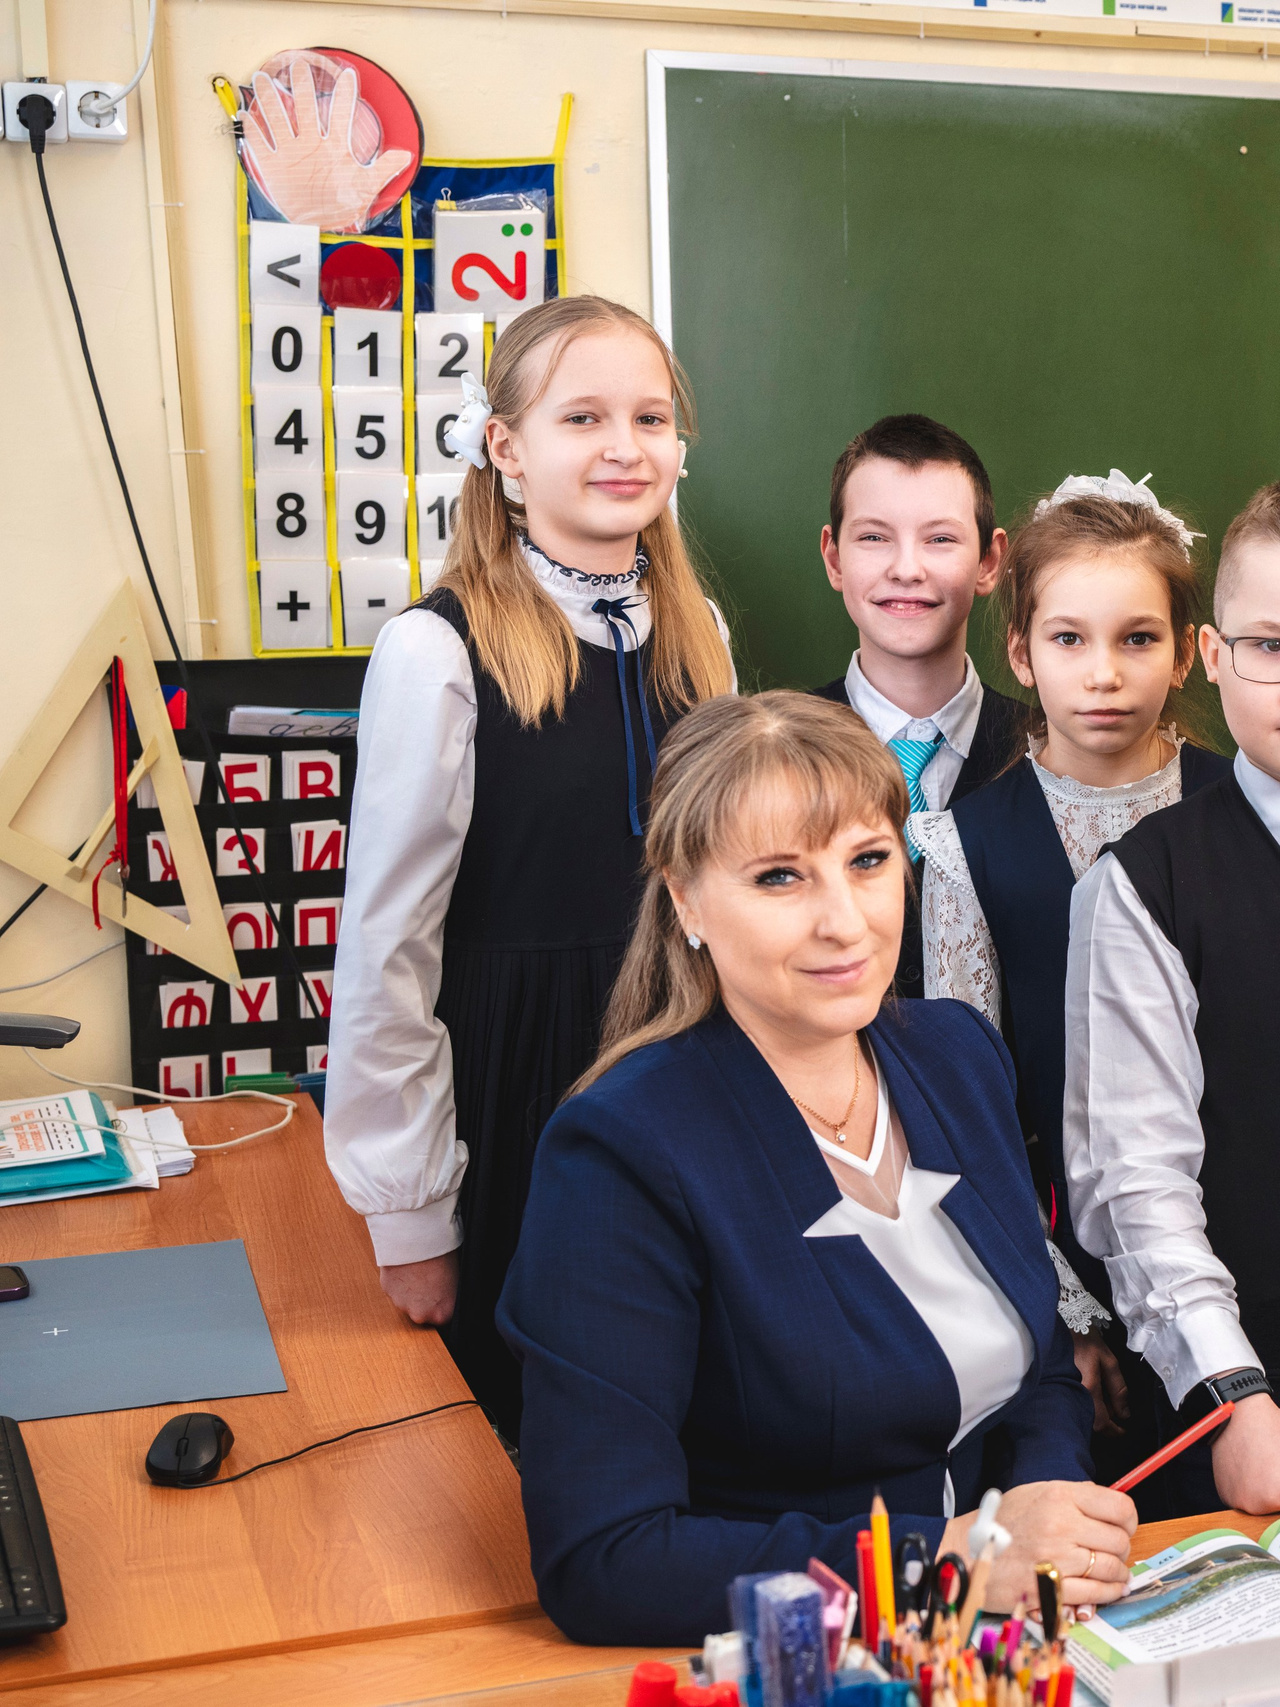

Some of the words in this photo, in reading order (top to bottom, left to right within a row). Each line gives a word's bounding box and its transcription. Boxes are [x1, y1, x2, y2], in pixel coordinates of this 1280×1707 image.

[271, 326, 302, 372] 0
[357, 332, 379, 376] 1
[438, 333, 469, 378] 2
[274, 409, 308, 454] 4
[355, 415, 386, 459] 5
[276, 492, 307, 538] 8
[355, 500, 386, 545] 9
